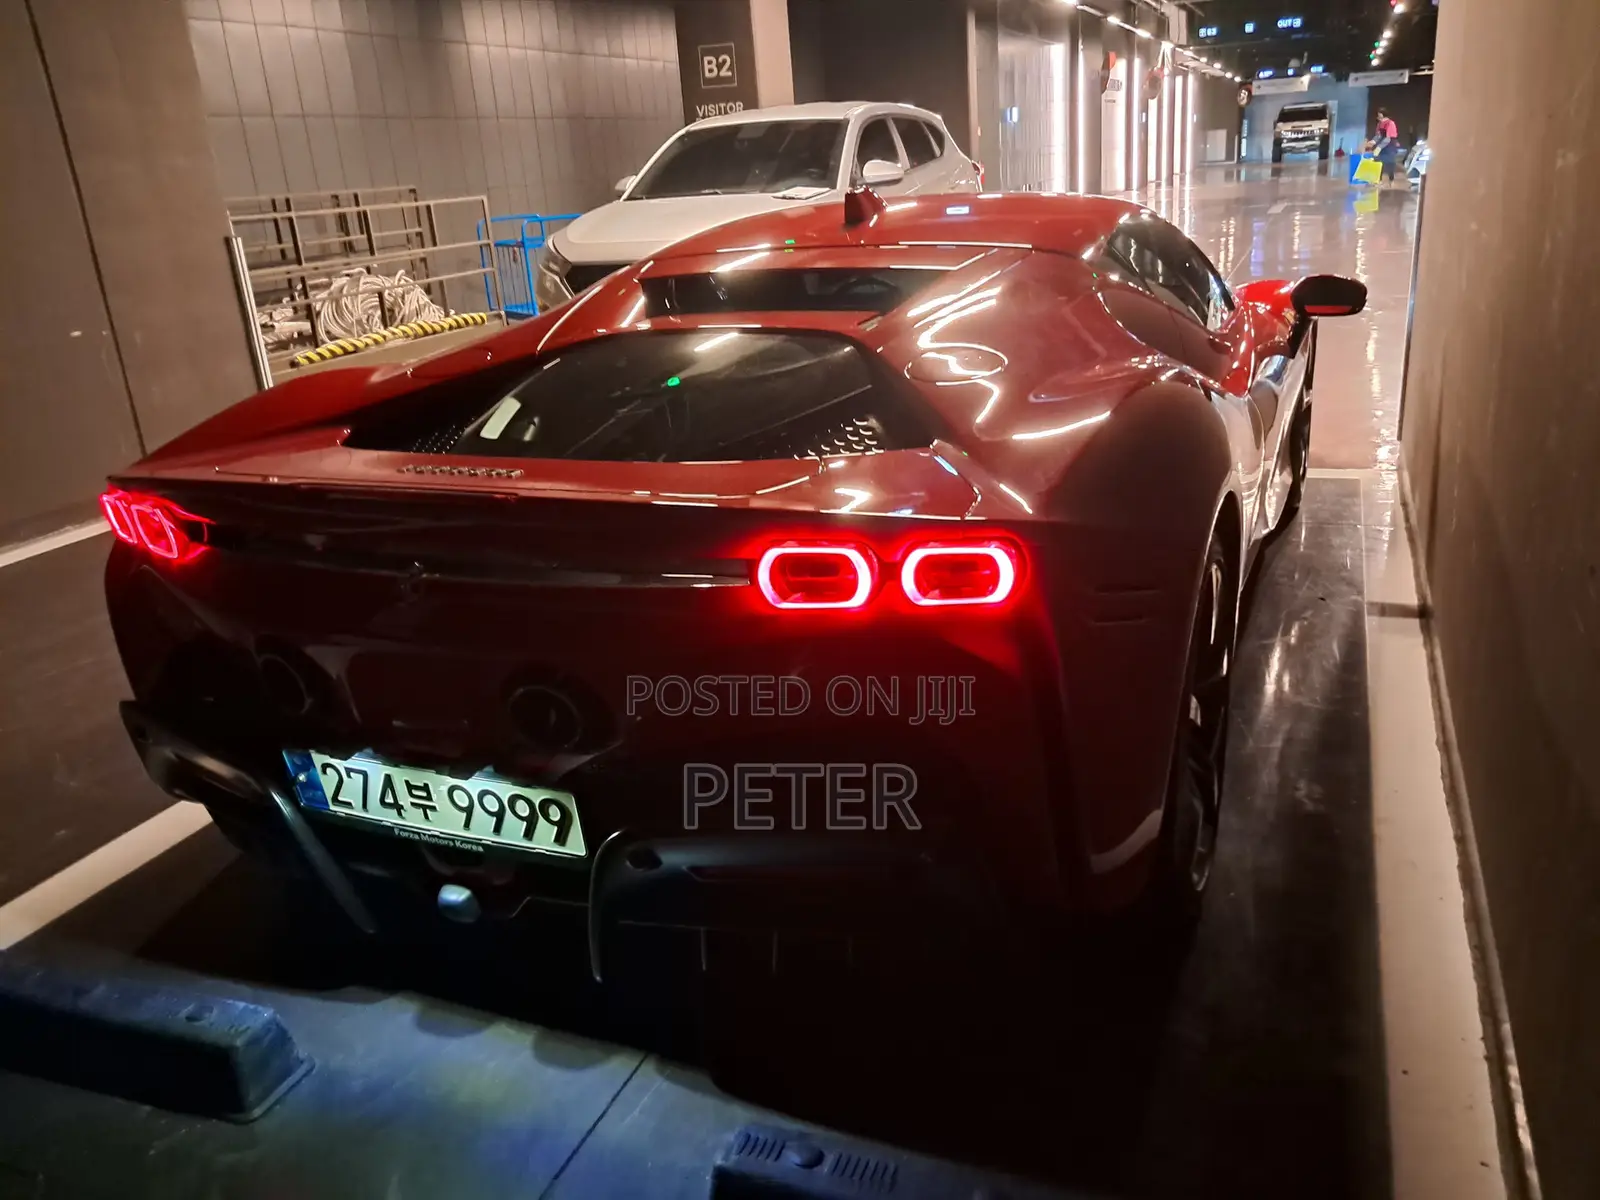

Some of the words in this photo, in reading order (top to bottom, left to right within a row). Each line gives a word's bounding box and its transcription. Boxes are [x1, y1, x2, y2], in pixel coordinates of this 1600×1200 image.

[703, 54, 732, 78] B2
[696, 102, 744, 117] VISITOR
[321, 762, 439, 822] 274부
[447, 784, 574, 847] 9999
[393, 827, 420, 840] Forza
[420, 833, 454, 848] Motors
[454, 840, 484, 853] Korea
